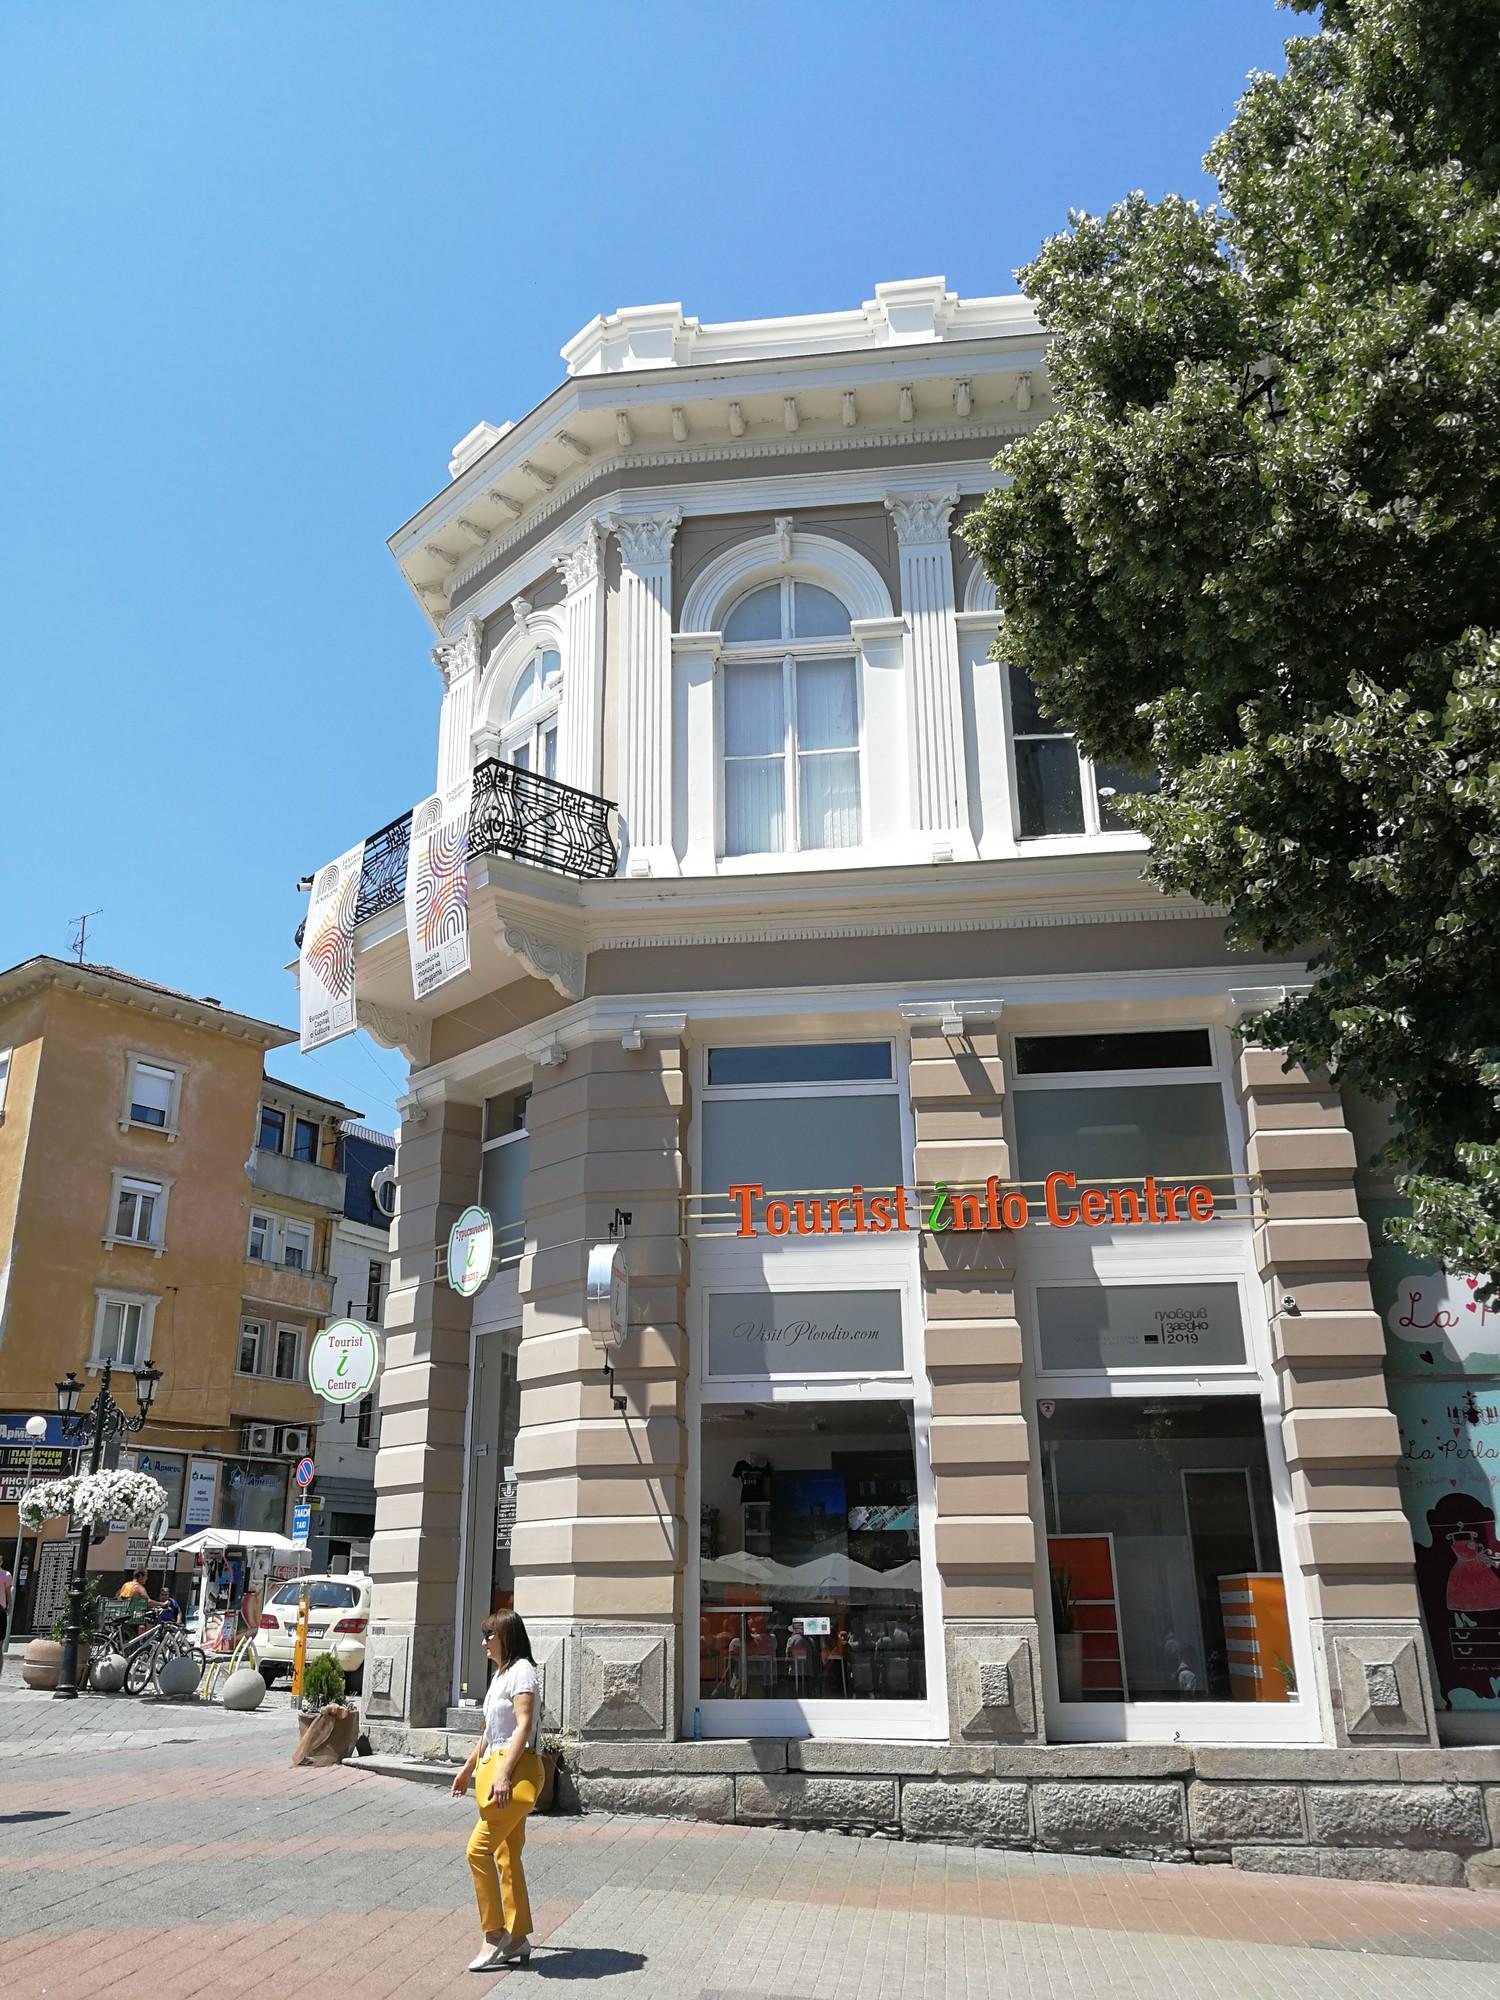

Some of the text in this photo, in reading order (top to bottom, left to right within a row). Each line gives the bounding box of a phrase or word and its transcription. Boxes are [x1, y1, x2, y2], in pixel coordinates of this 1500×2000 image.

[309, 1009, 329, 1023] European
[313, 1015, 330, 1028] Capital
[315, 1025, 331, 1036] Culture
[728, 1170, 1216, 1238] Tourist info Centre
[1399, 1291, 1460, 1328] La
[328, 1336, 363, 1348] Tourist
[1167, 1333, 1199, 1345] 2019
[327, 1379, 357, 1391] Centre
[1403, 1439, 1499, 1461] La Perla
